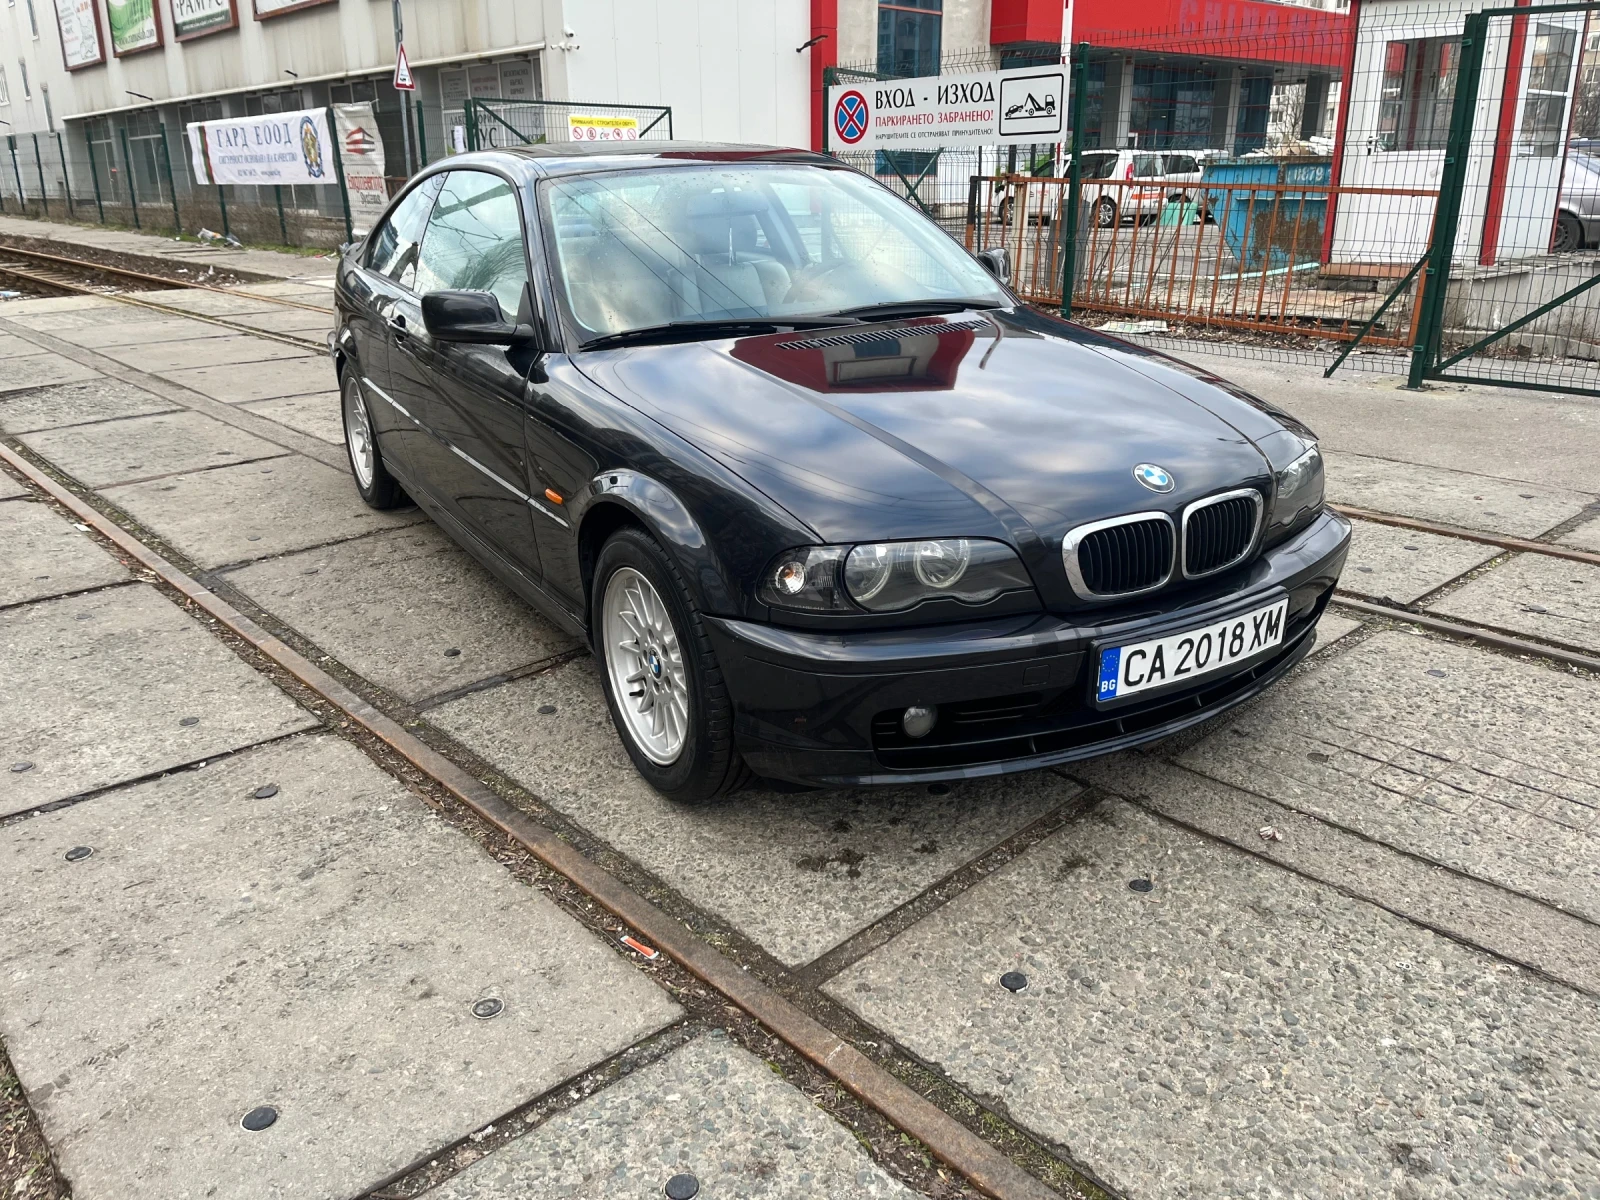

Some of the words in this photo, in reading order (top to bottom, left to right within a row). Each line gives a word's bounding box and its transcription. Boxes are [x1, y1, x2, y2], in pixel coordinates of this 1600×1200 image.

[876, 88, 916, 109] ВХОД
[937, 81, 995, 105] ИЗХОД
[875, 113, 934, 127] ПАРКИРАНЕТО
[937, 109, 994, 124] ЗАБРАНЕНО!
[216, 128, 248, 148] ГАРД
[254, 123, 292, 145] ЕООД
[917, 130, 950, 139] ОТСТРАНЯВАТ
[951, 128, 994, 137] ПРИНУДИТЕЛНО!
[347, 172, 384, 194] Engineering
[1124, 644, 1166, 687] CA
[1174, 621, 1245, 677] 2018
[1249, 605, 1283, 652] XM
[1101, 679, 1116, 693] BG
